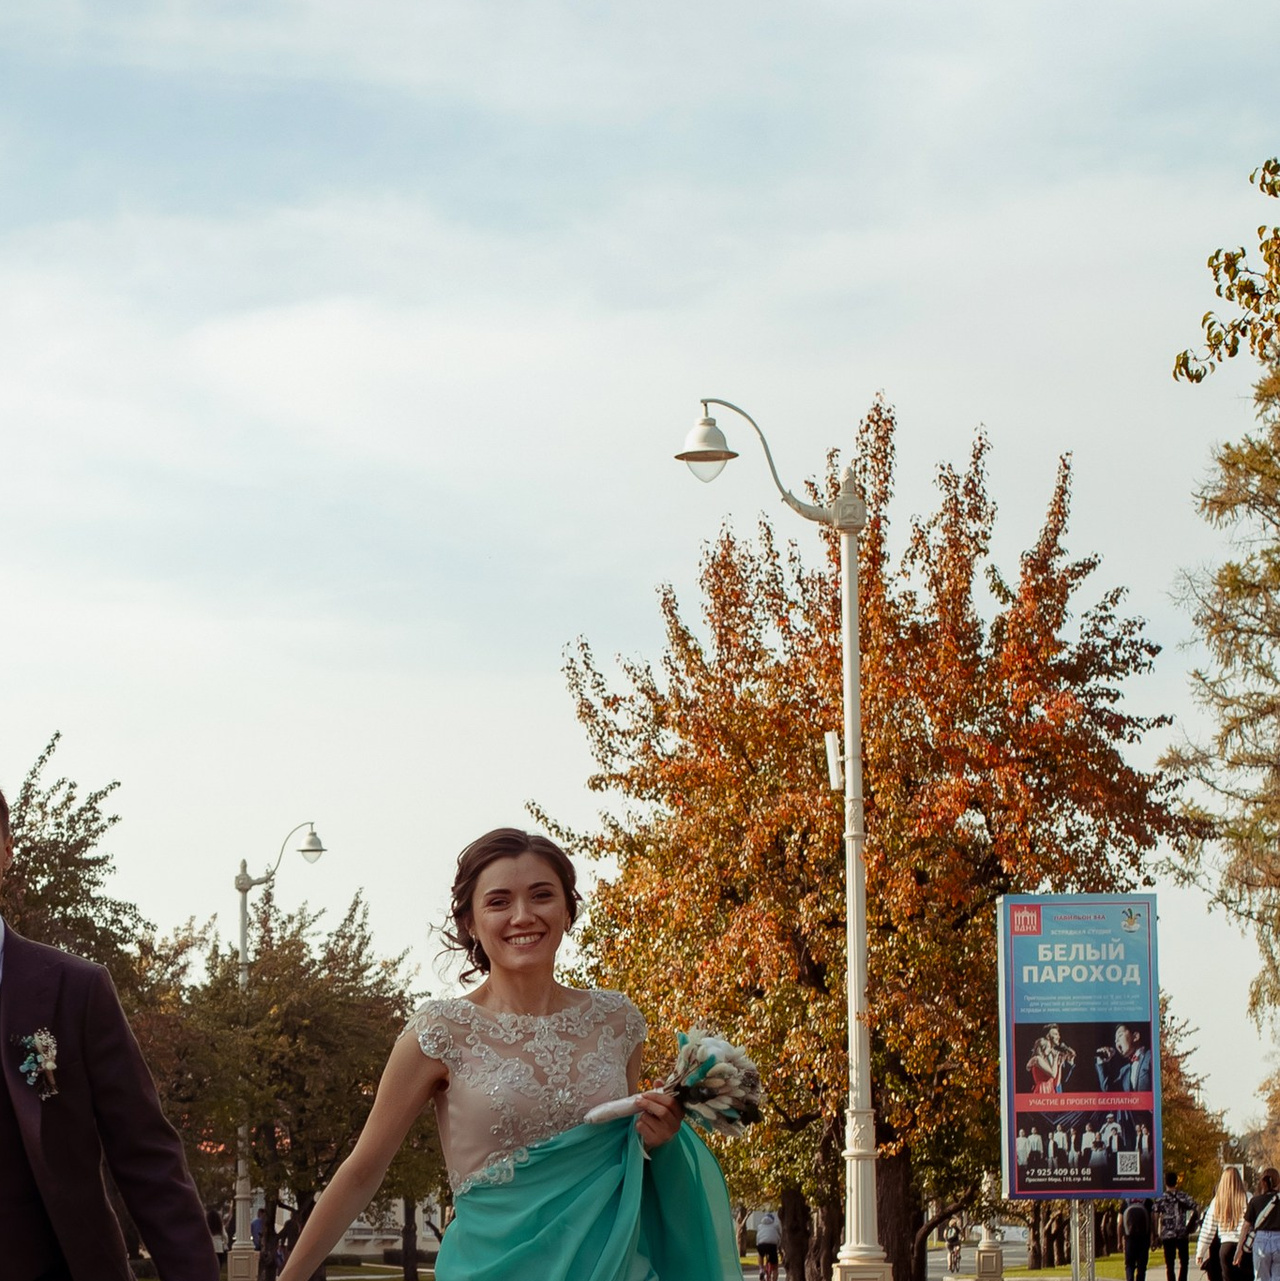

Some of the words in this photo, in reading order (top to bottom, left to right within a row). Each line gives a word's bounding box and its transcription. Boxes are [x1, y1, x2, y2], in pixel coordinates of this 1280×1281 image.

[1038, 937, 1125, 962] БЕЛЫЙ
[1022, 964, 1141, 985] ПАРОХОД
[1029, 1098, 1058, 1106] УЧАСТИЕ
[1098, 1097, 1139, 1105] БЕСПЛАТНО!
[1026, 1168, 1035, 1176] +7
[1037, 1168, 1052, 1176] 925
[1053, 1168, 1068, 1176] 409
[1081, 1167, 1092, 1175] 68
